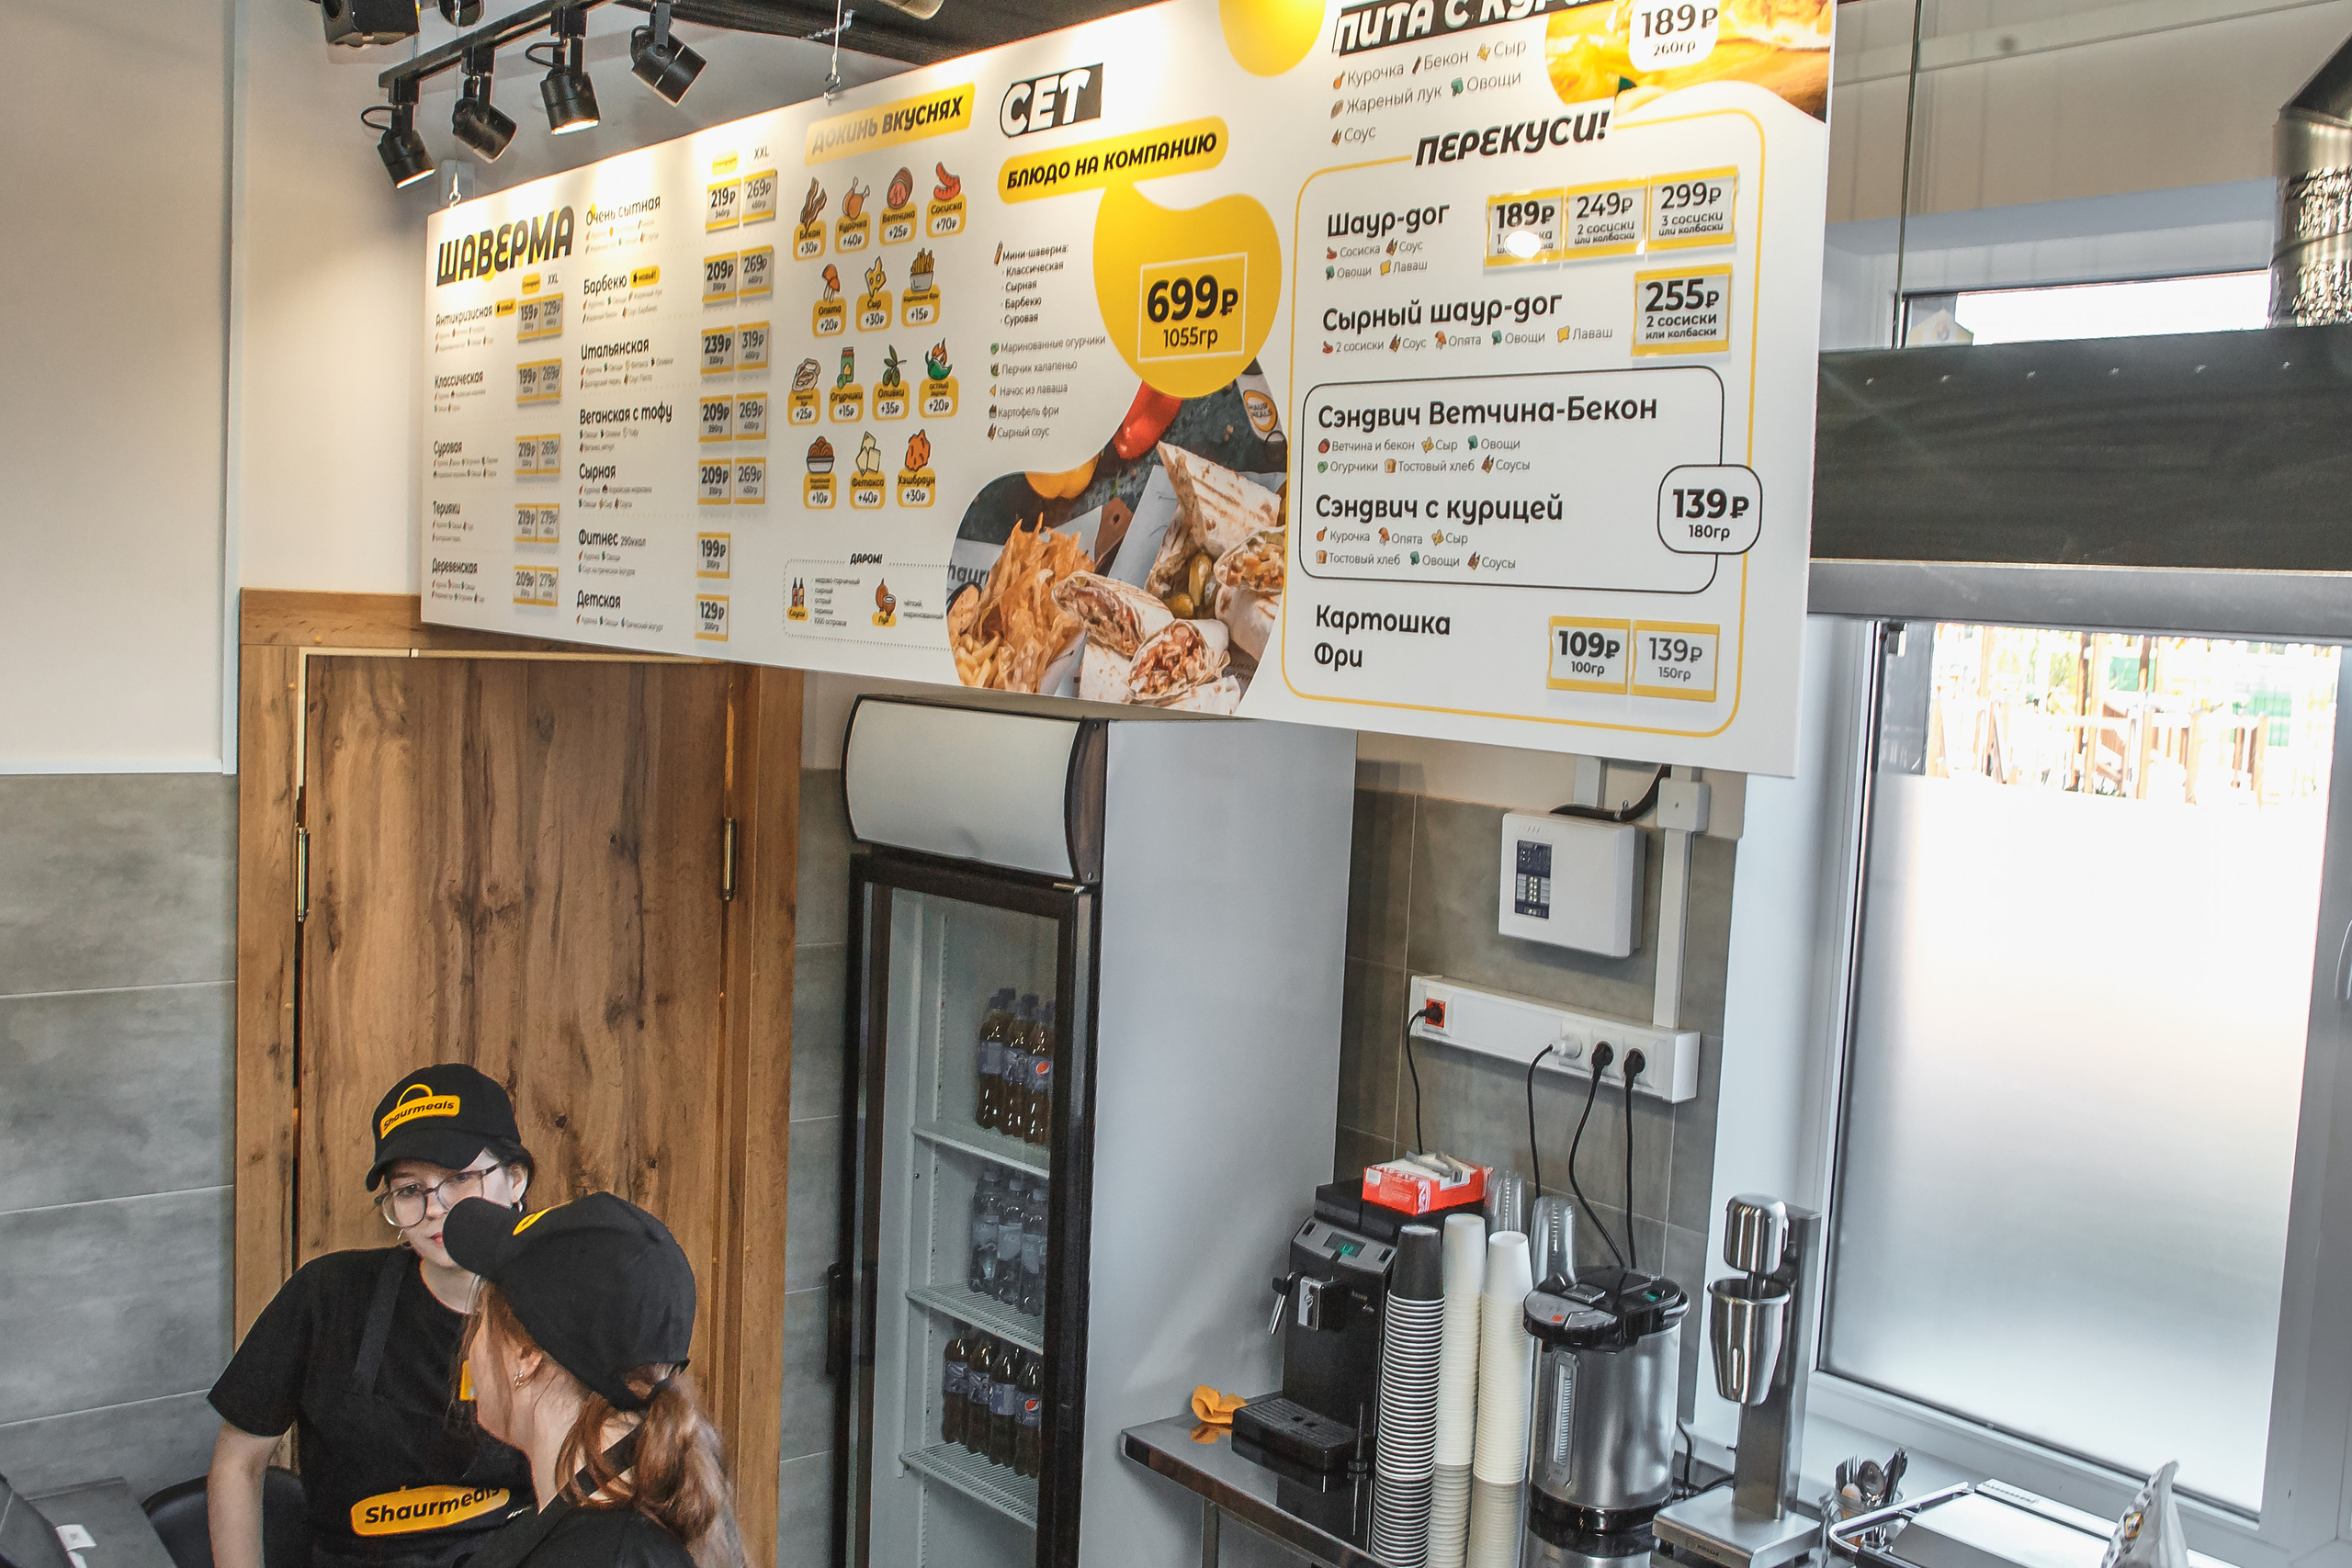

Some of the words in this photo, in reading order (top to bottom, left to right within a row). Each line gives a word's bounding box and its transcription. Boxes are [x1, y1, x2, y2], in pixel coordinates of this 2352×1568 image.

[1332, 0, 1435, 52] ПИТА
[1654, 40, 1697, 57] 260гр
[1347, 62, 1405, 87] Курочка
[1424, 51, 1469, 71] Бекон
[1494, 40, 1527, 57] Сыр
[1001, 68, 1091, 137] СЕТ
[1346, 89, 1413, 114] Жареный
[1417, 85, 1442, 102] лук
[1467, 73, 1521, 92] Овощи
[811, 117, 878, 155] ДОКИНЬ
[882, 95, 964, 134] ВКУСНЯХ
[1344, 126, 1376, 144] Соус
[1415, 108, 1611, 166] ПЕРЕКУСИ!
[753, 146, 769, 159] XXL
[1006, 162, 1070, 190] БЛЮДО
[1075, 157, 1100, 176] НА
[1104, 130, 1218, 172] КОМПАНИЮ
[585, 209, 616, 226] Очень
[618, 195, 661, 220] сытная
[882, 209, 915, 223] Ветчина
[931, 200, 962, 215] Сосиска
[1328, 204, 1450, 239] Шаур-дог
[1577, 224, 1584, 235] 2
[1587, 220, 1634, 235] сосиски
[1661, 214, 1668, 227] 3
[1671, 211, 1723, 227] сосиски
[1574, 236, 1590, 245] или
[1592, 231, 1635, 243] колбаски
[1658, 227, 1676, 238] или
[1679, 221, 1724, 235] колбаски
[436, 205, 574, 287] ШАВЕРМА
[1340, 244, 1381, 257] Сосиска
[1399, 241, 1423, 254] Соус
[1006, 261, 1064, 277] Классическая
[1337, 265, 1372, 278] Овощи
[1393, 260, 1428, 274] Лаваш
[583, 274, 628, 297] Барбекю
[1005, 280, 1037, 293] Сырная
[866, 299, 882, 310] Сыр
[1004, 296, 1042, 310] Барбекю
[1004, 313, 1038, 328] Суровая
[1322, 299, 1422, 335] Сырный
[1430, 293, 1563, 327] шаур-дог
[1646, 315, 1654, 328] 2
[1657, 313, 1717, 327] сосиски
[1163, 327, 1218, 349] 1055гр
[1336, 341, 1341, 353] 2
[1343, 340, 1385, 353] сосиски
[1402, 337, 1427, 351] Соус
[1448, 334, 1482, 347] Опята
[1505, 332, 1545, 345] Овощи
[1572, 327, 1613, 342] Лаваш
[1645, 331, 1665, 340] или
[1668, 327, 1717, 340] колбаски
[581, 338, 649, 361] Итальянская
[1001, 339, 1063, 354] Маринованные
[1066, 335, 1106, 350] огурчики
[1001, 364, 1032, 376] Перчик
[1034, 361, 1078, 373] халапеньо
[435, 371, 483, 389] Классическая
[877, 388, 905, 399] Оливки
[1000, 386, 1024, 396] Начос
[1026, 386, 1035, 395] из
[1037, 384, 1068, 394] лаваша
[580, 407, 630, 425] Веганская
[633, 406, 639, 421] с
[641, 400, 673, 423] тофу
[998, 406, 1040, 420] Картофель
[1042, 404, 1059, 418] фри
[1317, 405, 1421, 434] Сэндвич
[1429, 395, 1657, 426] Ветчина-Бекон
[997, 426, 1030, 439] Сырный
[1032, 427, 1050, 438] соус
[1332, 440, 1373, 453] Ветчина
[1374, 444, 1382, 452] и
[1384, 439, 1415, 452] бекон
[1435, 440, 1458, 455] Сыр
[1481, 438, 1521, 451] Овощи
[579, 462, 616, 483] Сырная
[1330, 460, 1378, 474] Огурчики
[1398, 459, 1446, 472] Тостовый
[1449, 458, 1475, 472] хлеб
[1496, 459, 1531, 473] Соусы
[1316, 494, 1418, 525] Сэндвич
[1425, 499, 1439, 519] с
[1447, 493, 1563, 525] курицей
[578, 528, 618, 547] Фитнес
[1329, 531, 1370, 544] Курочка
[1392, 533, 1423, 545] Опята
[1445, 532, 1468, 546] Сыр
[1689, 525, 1730, 542] 180гр
[849, 553, 883, 566] ДАРОМ!
[1329, 552, 1374, 565] Тостовый
[1376, 553, 1400, 566] хлеб
[1423, 554, 1460, 568] Овощи
[1482, 556, 1516, 570] Соусы
[576, 589, 621, 609] Детская
[1316, 604, 1452, 637] Картошка
[1314, 641, 1363, 671] Фри
[1570, 660, 1605, 677] 100гр
[1658, 666, 1691, 682] 150гр
[383, 1100, 455, 1131] Shaurmeals
